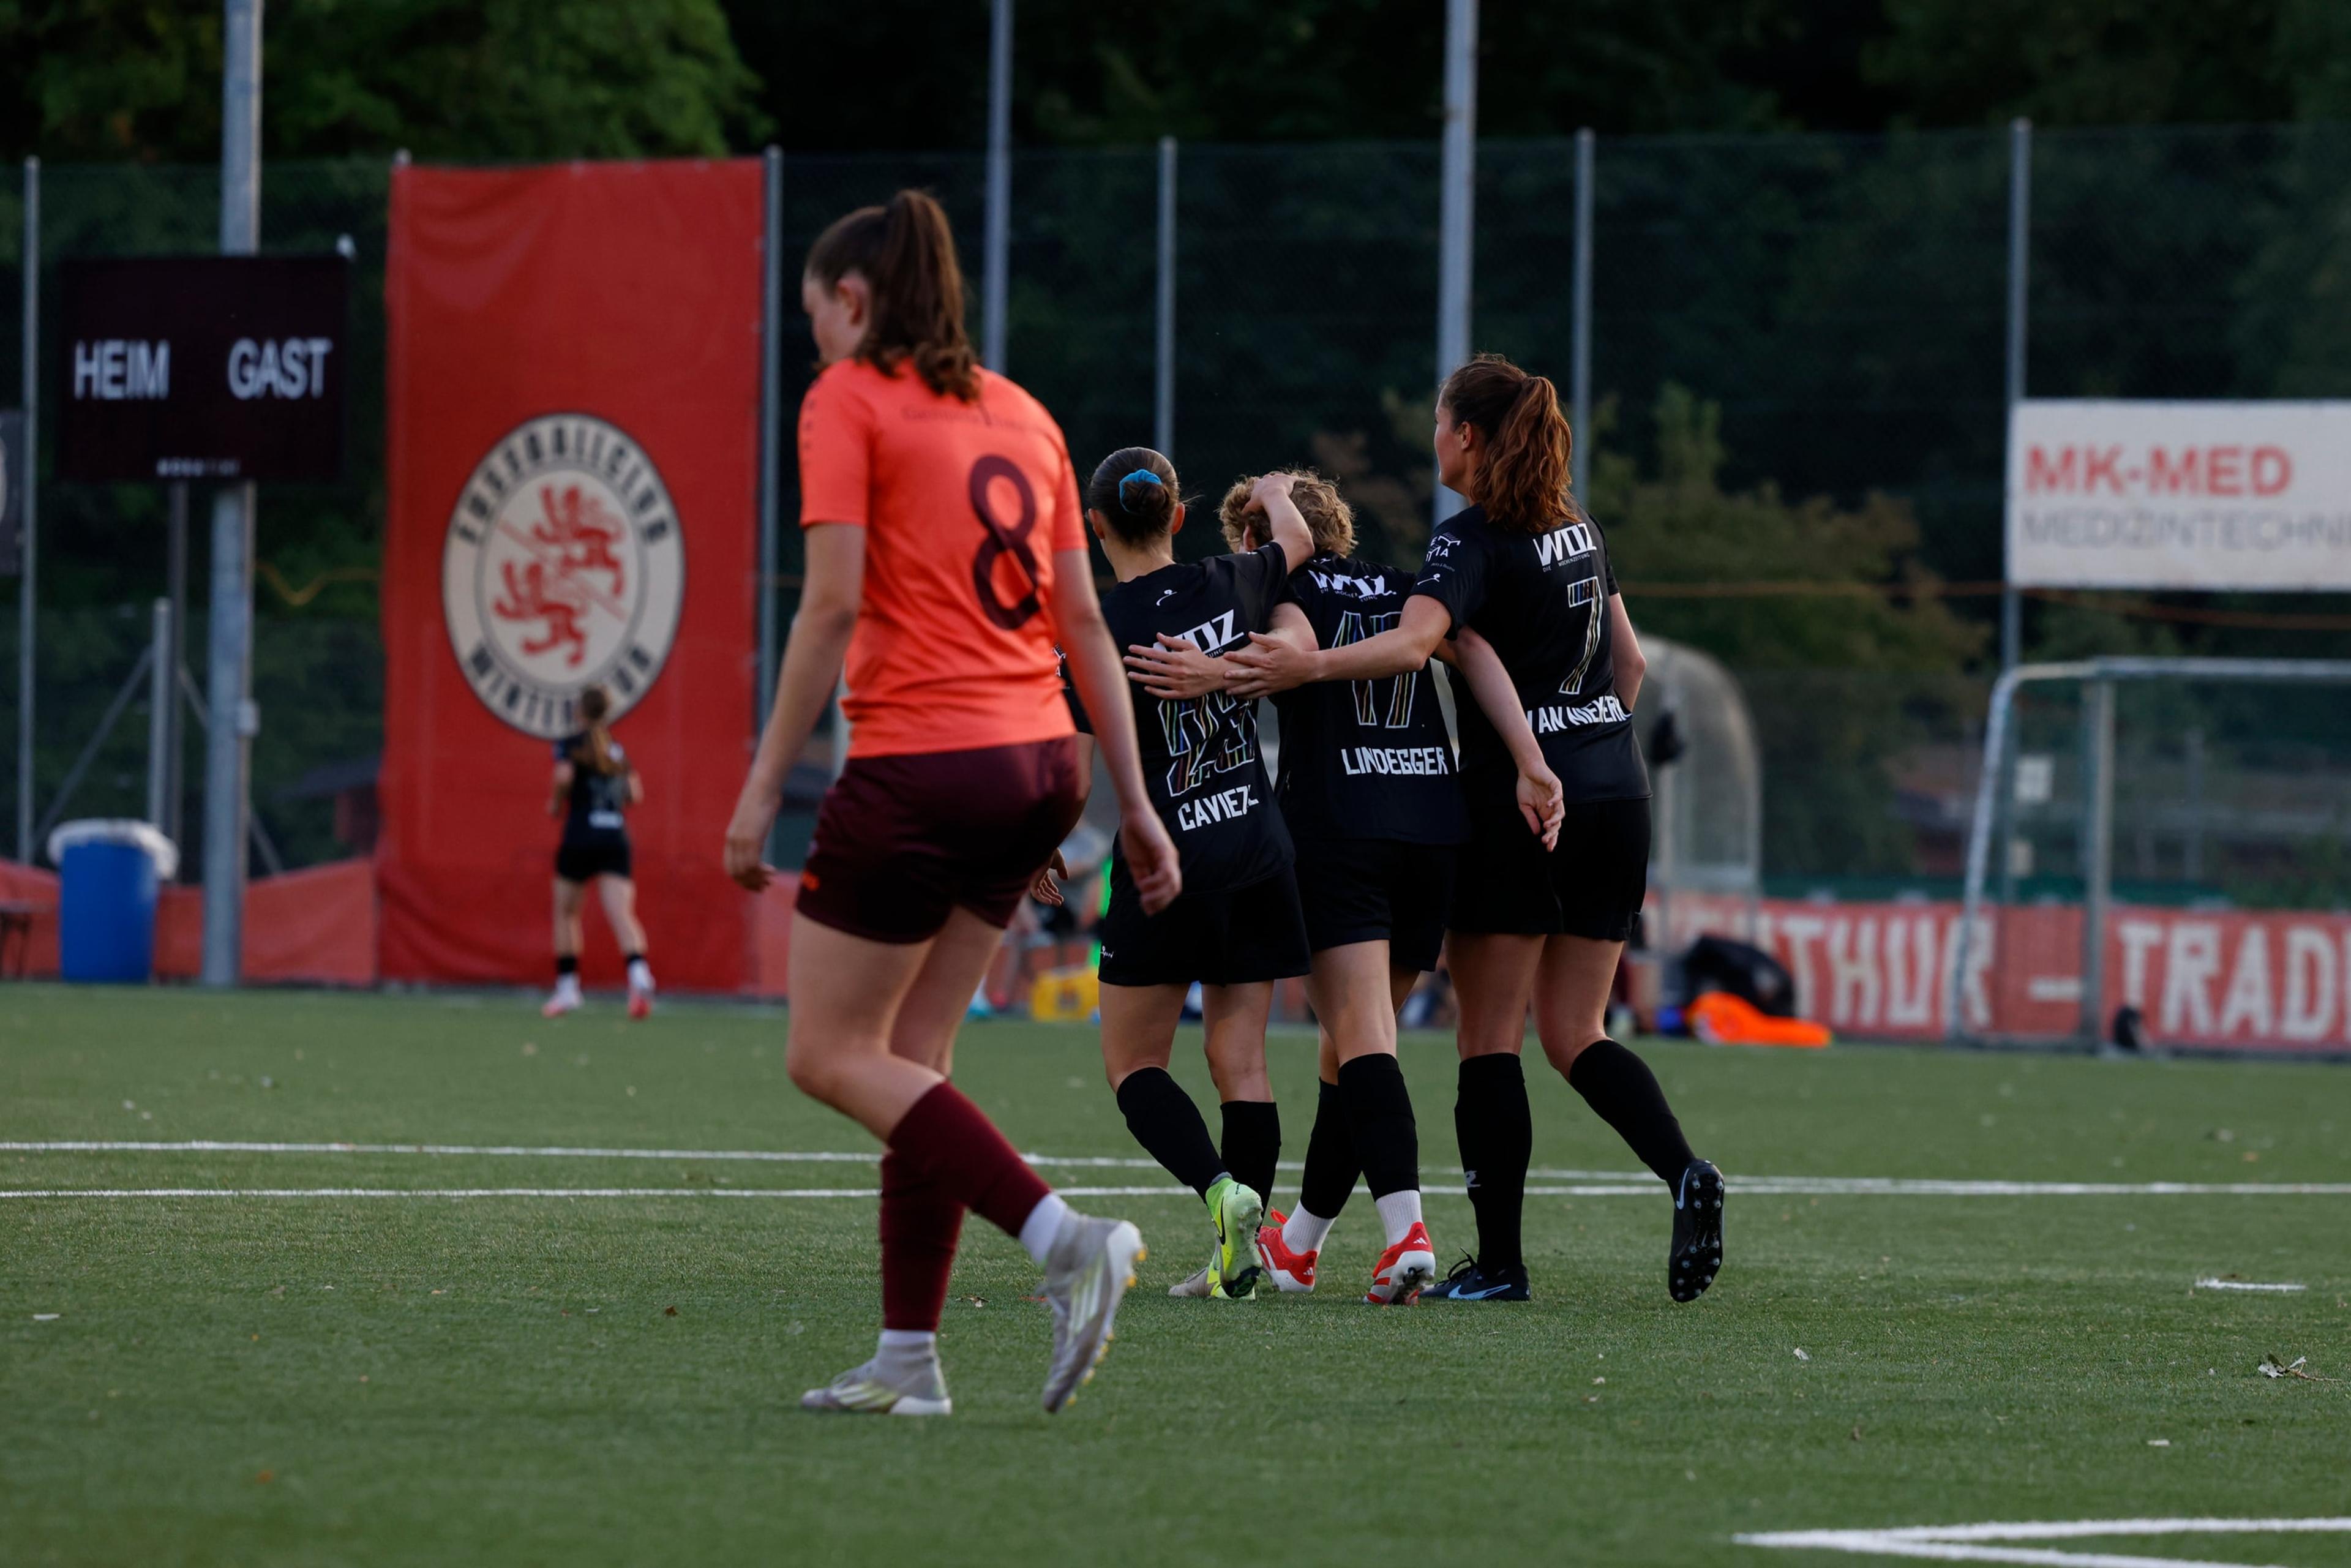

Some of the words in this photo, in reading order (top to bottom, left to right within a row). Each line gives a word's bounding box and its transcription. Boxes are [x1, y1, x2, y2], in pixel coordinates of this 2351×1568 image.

[74, 339, 170, 399] HEIM
[228, 337, 332, 400] GAST
[2025, 443, 2293, 497] MK-MED
[969, 454, 1040, 631] 8
[1532, 523, 1597, 566] WOZ
[1558, 576, 1603, 695] 7
[1341, 746, 1449, 776] LINDEGGER
[1177, 784, 1259, 831] CAVIEZ
[2117, 920, 2351, 1041] TRAD
